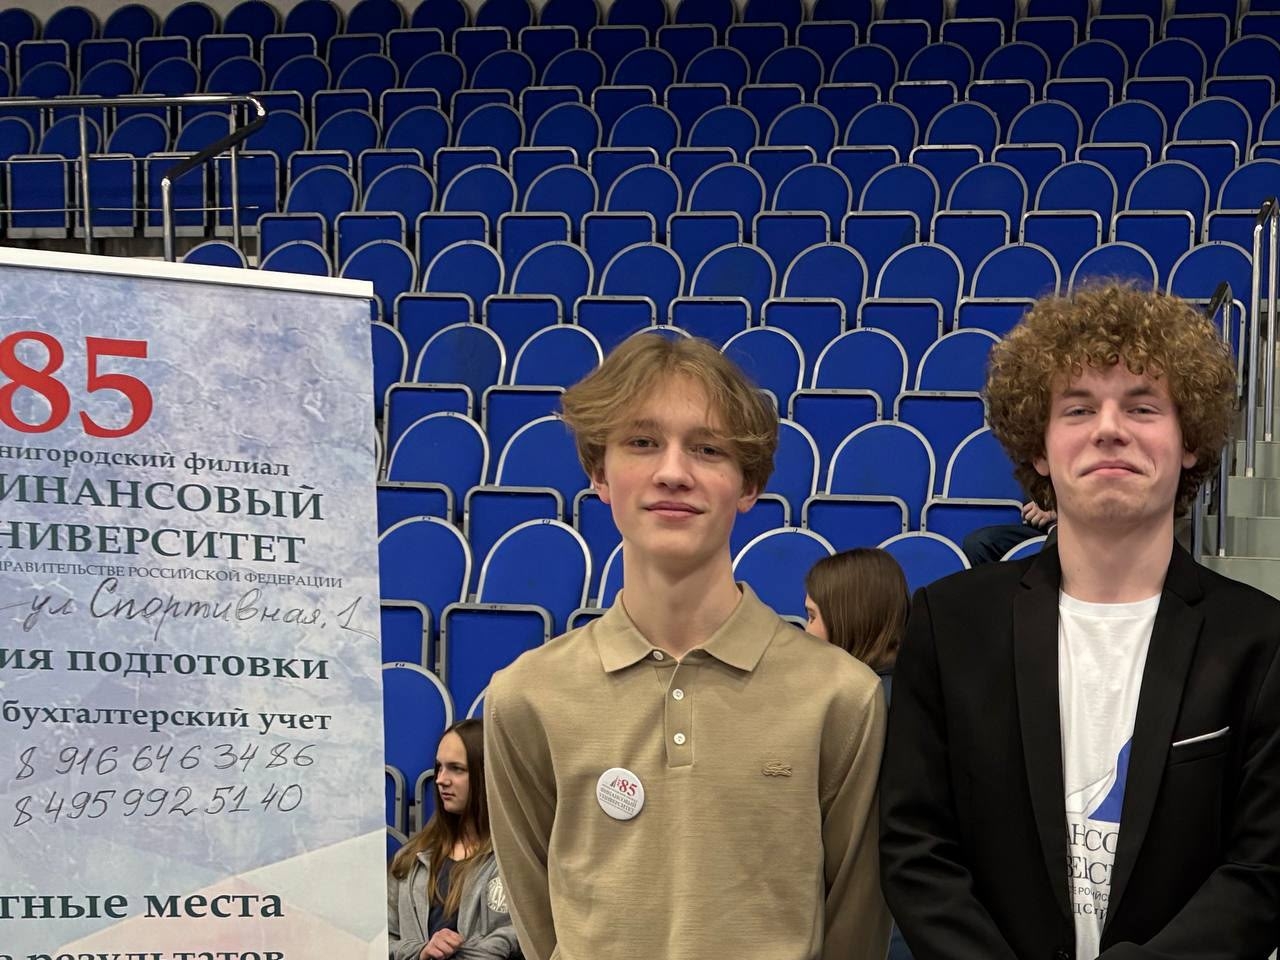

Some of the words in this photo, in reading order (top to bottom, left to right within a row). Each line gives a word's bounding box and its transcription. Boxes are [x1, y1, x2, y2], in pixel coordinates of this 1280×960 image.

[184, 452, 290, 477] филиал
[128, 565, 240, 583] РОССИЙСКОЙ
[245, 572, 342, 589] ФЕДЕРАЦИИ
[67, 650, 329, 680] подготовки
[2, 700, 249, 732] бухгалтерский
[259, 711, 331, 735] учет
[15, 747, 37, 780] 8
[55, 746, 119, 775] 916
[214, 744, 257, 772] 34
[266, 743, 316, 770] 86
[14, 796, 33, 827] 8
[45, 790, 116, 824] 495
[123, 787, 199, 817] 992
[204, 786, 251, 815] 51
[260, 783, 303, 813] 40
[144, 893, 285, 919] места
